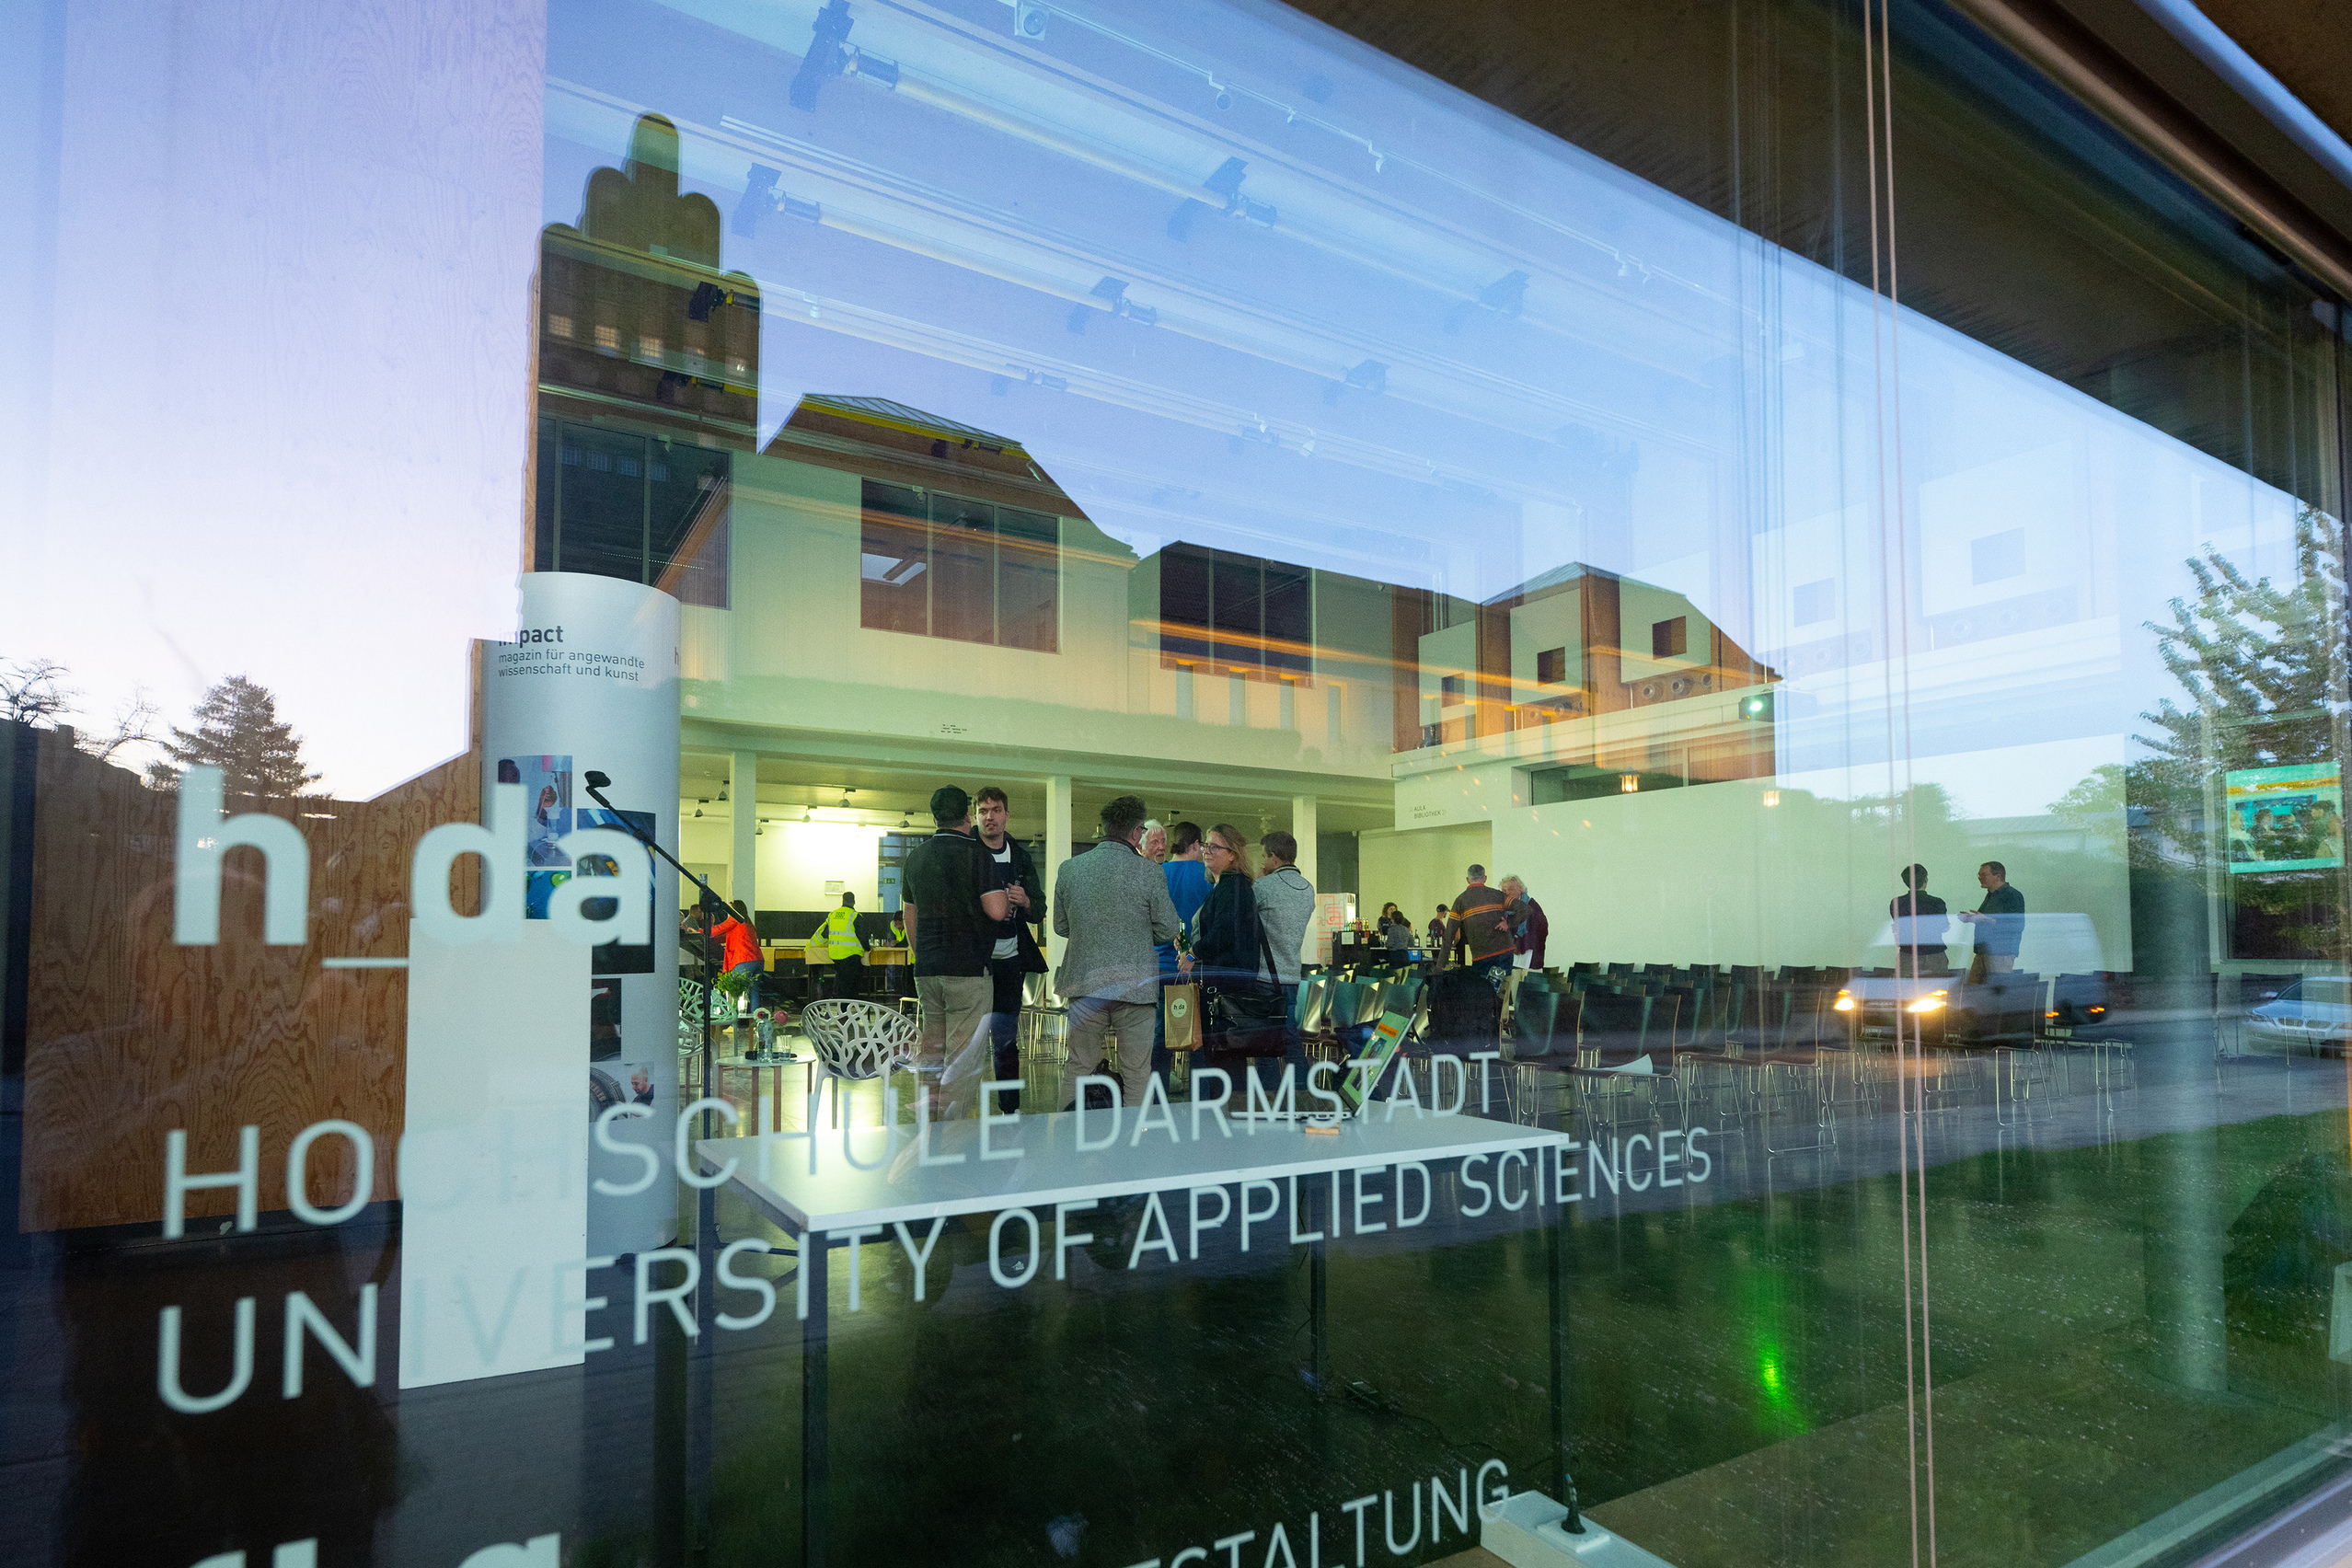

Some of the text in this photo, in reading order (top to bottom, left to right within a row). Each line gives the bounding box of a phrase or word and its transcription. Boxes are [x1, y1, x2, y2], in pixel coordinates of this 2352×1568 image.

[498, 649, 645, 669] magazin für angewandte
[498, 663, 640, 682] wissenschaft und kunst
[172, 764, 654, 970] h_da
[1076, 1051, 1501, 1153] DARMSTADT
[156, 1126, 1712, 1416] UNIVERSITY OF APPLIED SCIENCES
